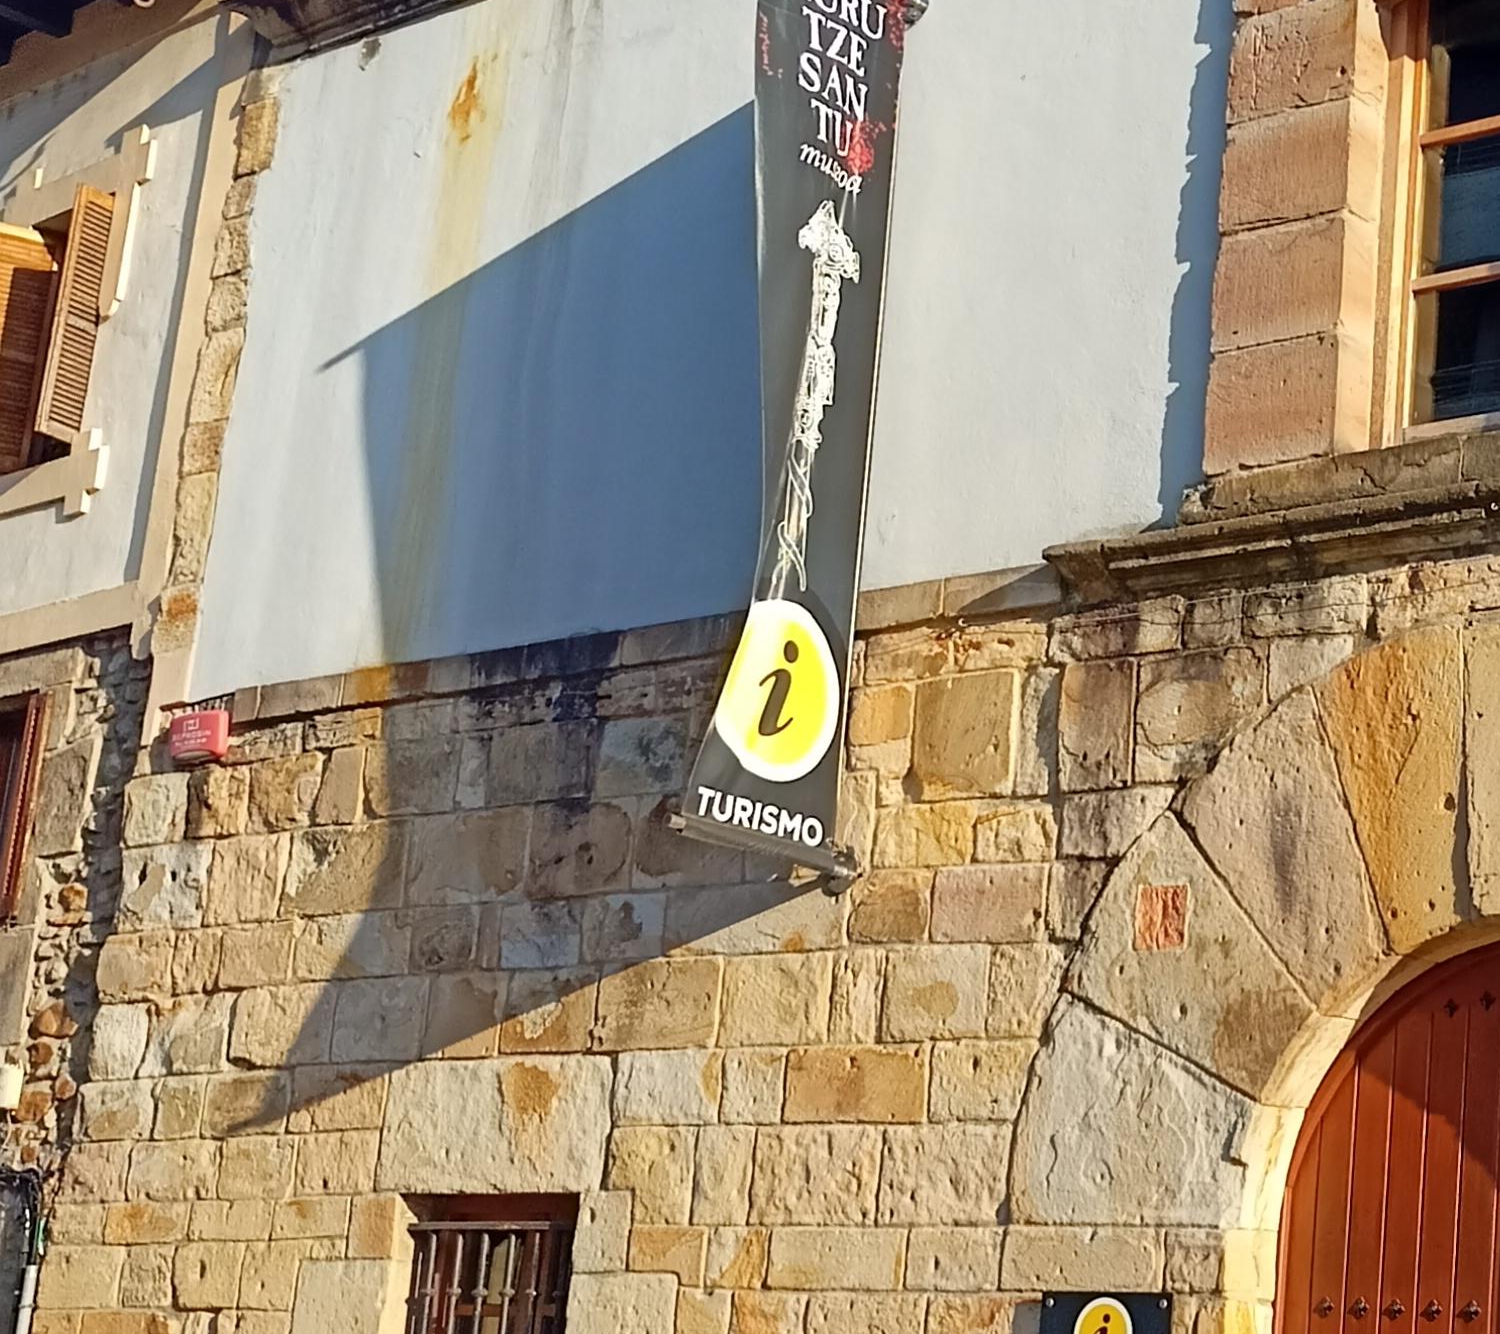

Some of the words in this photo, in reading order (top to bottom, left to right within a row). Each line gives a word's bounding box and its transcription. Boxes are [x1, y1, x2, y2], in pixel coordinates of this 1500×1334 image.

[802, 5, 868, 77] TZE
[798, 51, 868, 122] SAN
[810, 98, 853, 156] TU
[697, 786, 824, 847] TURISMO
